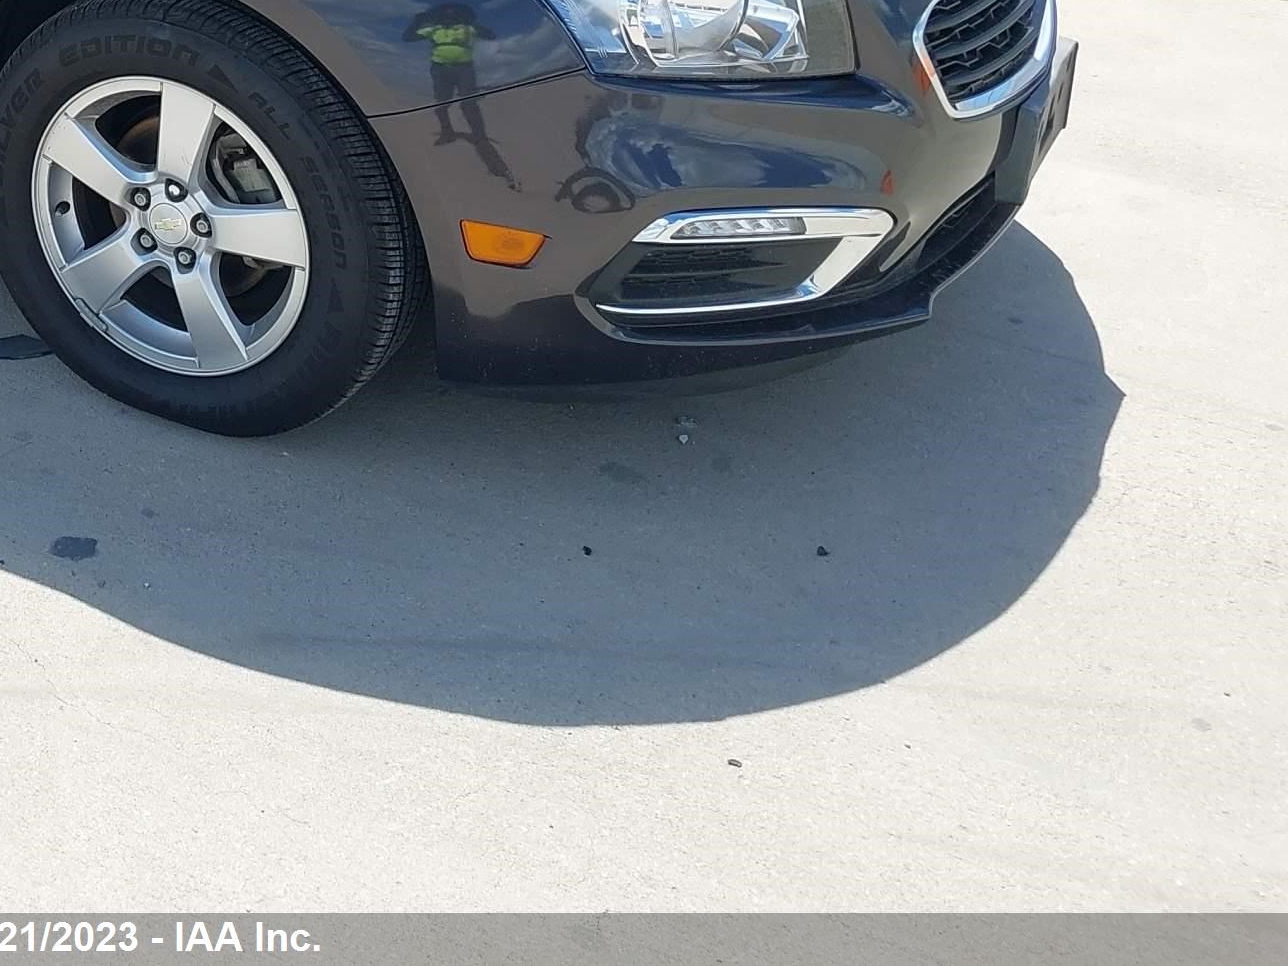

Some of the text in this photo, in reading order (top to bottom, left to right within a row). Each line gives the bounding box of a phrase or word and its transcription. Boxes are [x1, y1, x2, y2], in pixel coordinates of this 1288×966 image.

[59, 33, 201, 67] EDITION
[247, 91, 295, 140] ALL
[298, 154, 347, 269] SEASON
